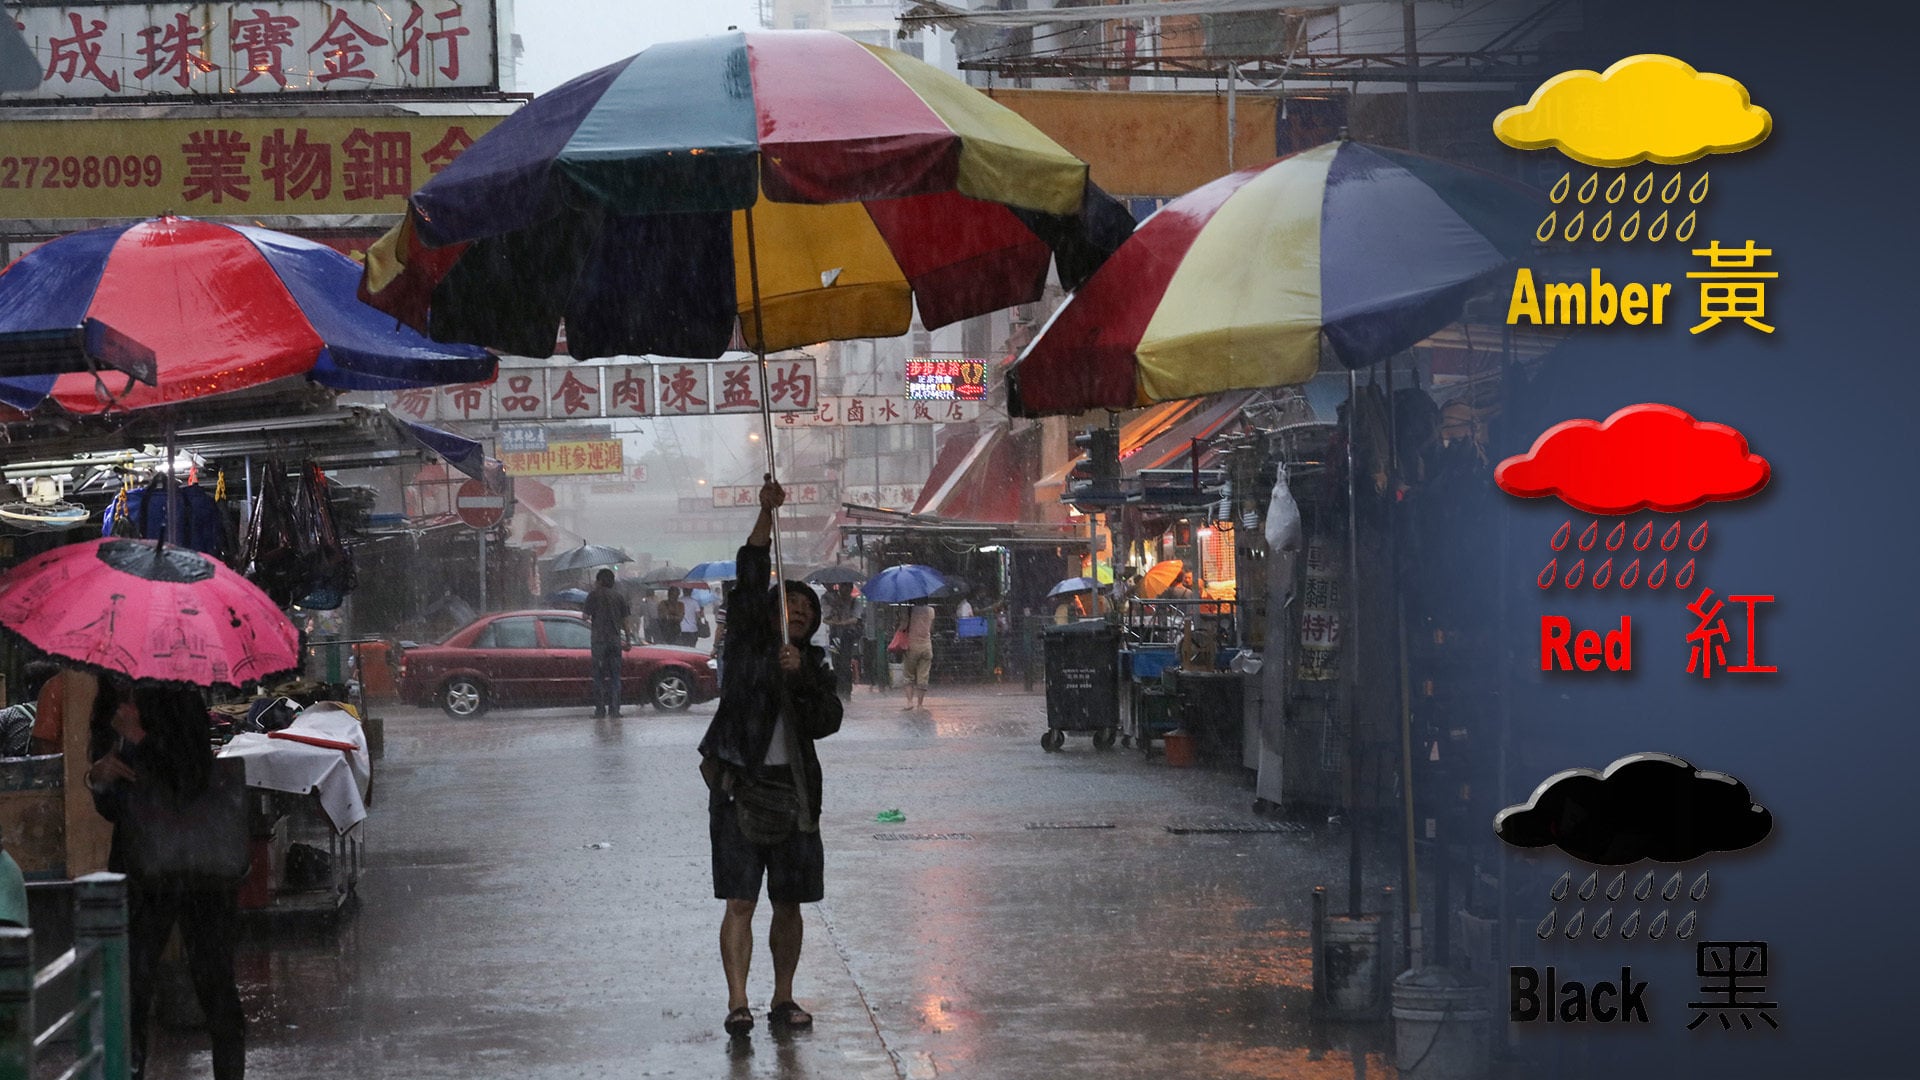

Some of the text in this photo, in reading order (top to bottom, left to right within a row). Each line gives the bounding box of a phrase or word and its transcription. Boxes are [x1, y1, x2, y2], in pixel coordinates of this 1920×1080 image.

[16, 5, 470, 92] 成珠寶金行
[1, 155, 162, 189] 27298099
